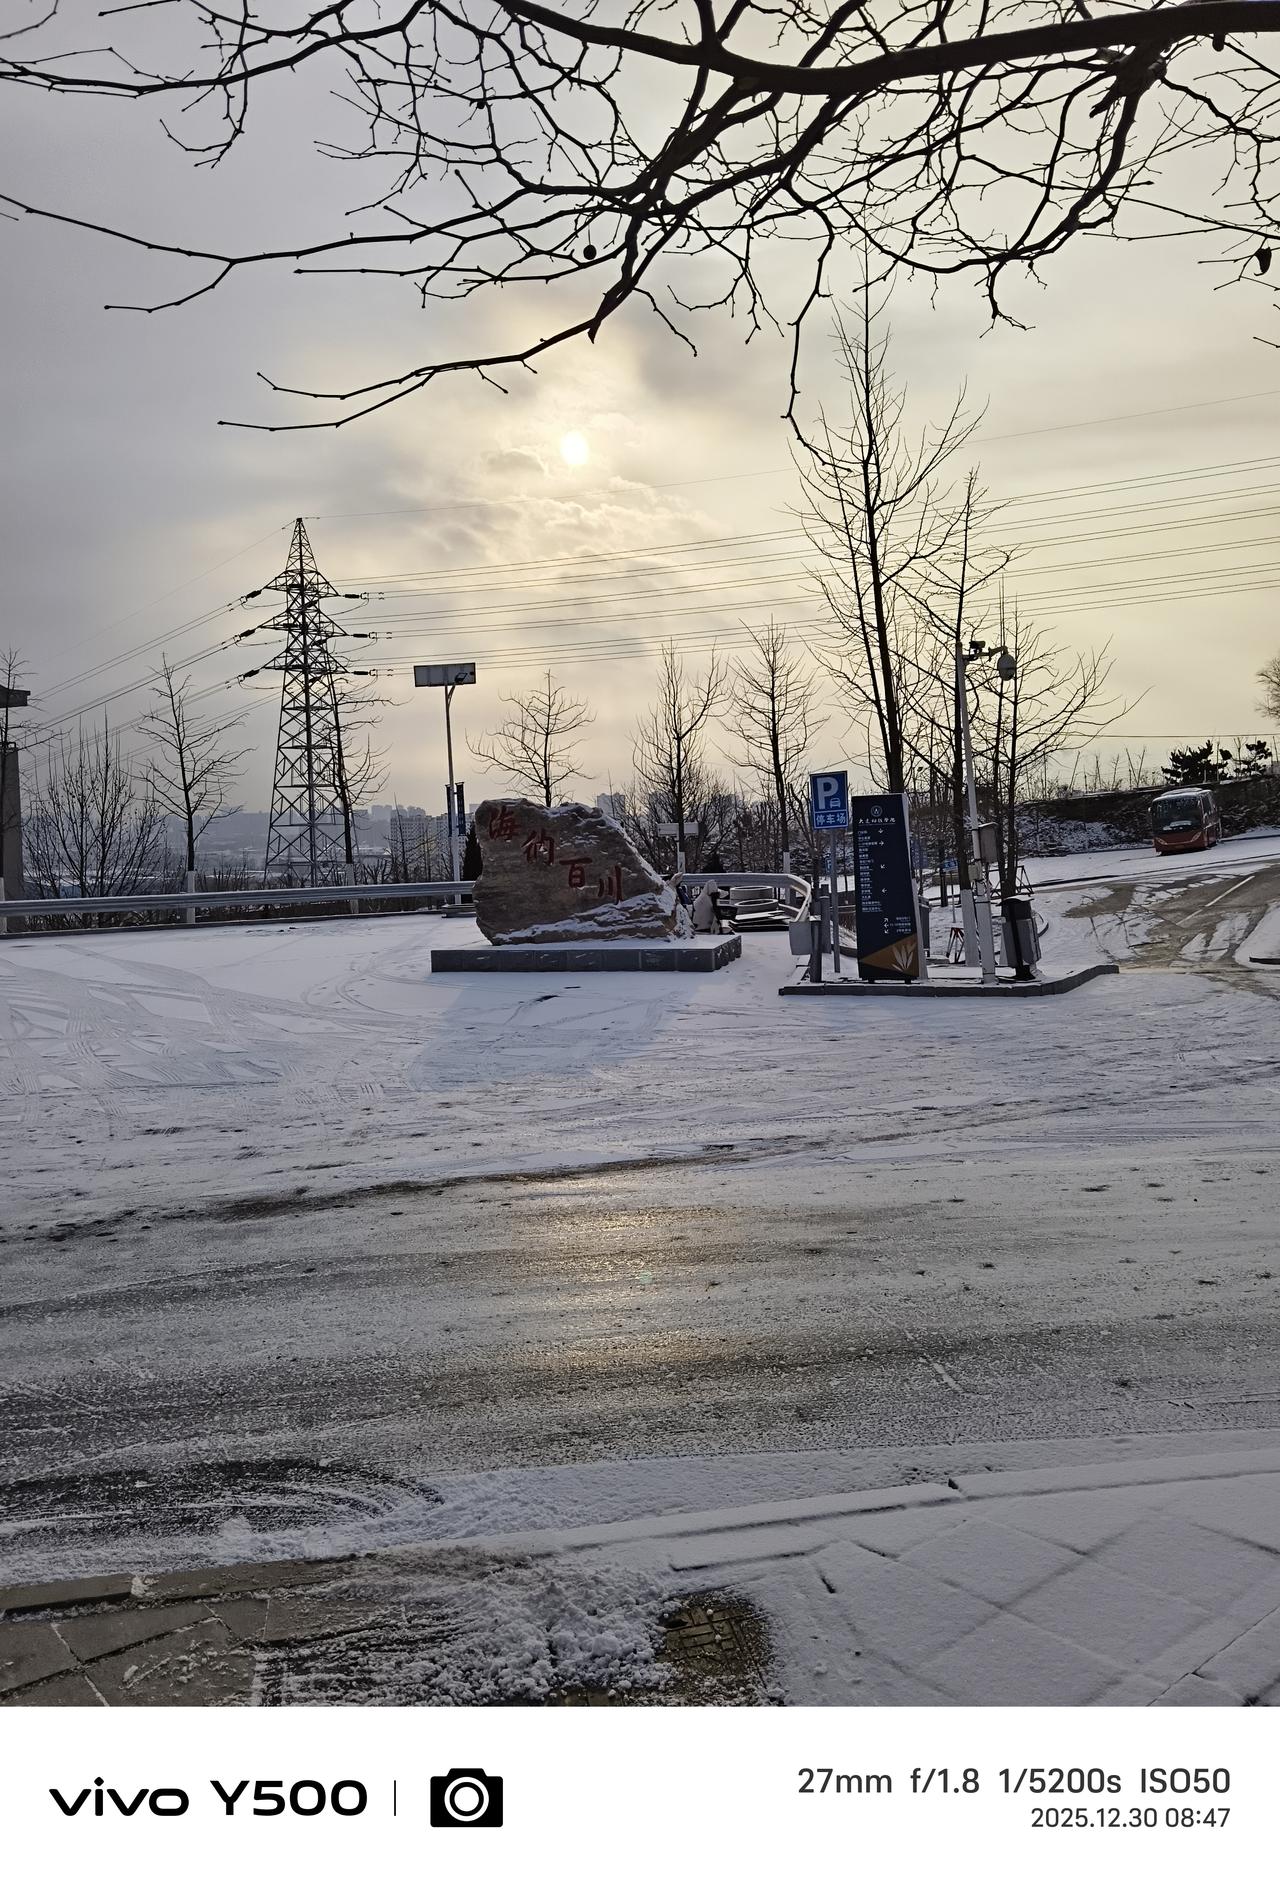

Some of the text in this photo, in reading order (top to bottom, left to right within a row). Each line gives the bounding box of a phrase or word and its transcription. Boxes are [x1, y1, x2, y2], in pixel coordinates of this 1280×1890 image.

[817, 777, 839, 809] P
[816, 812, 846, 826] 停车场
